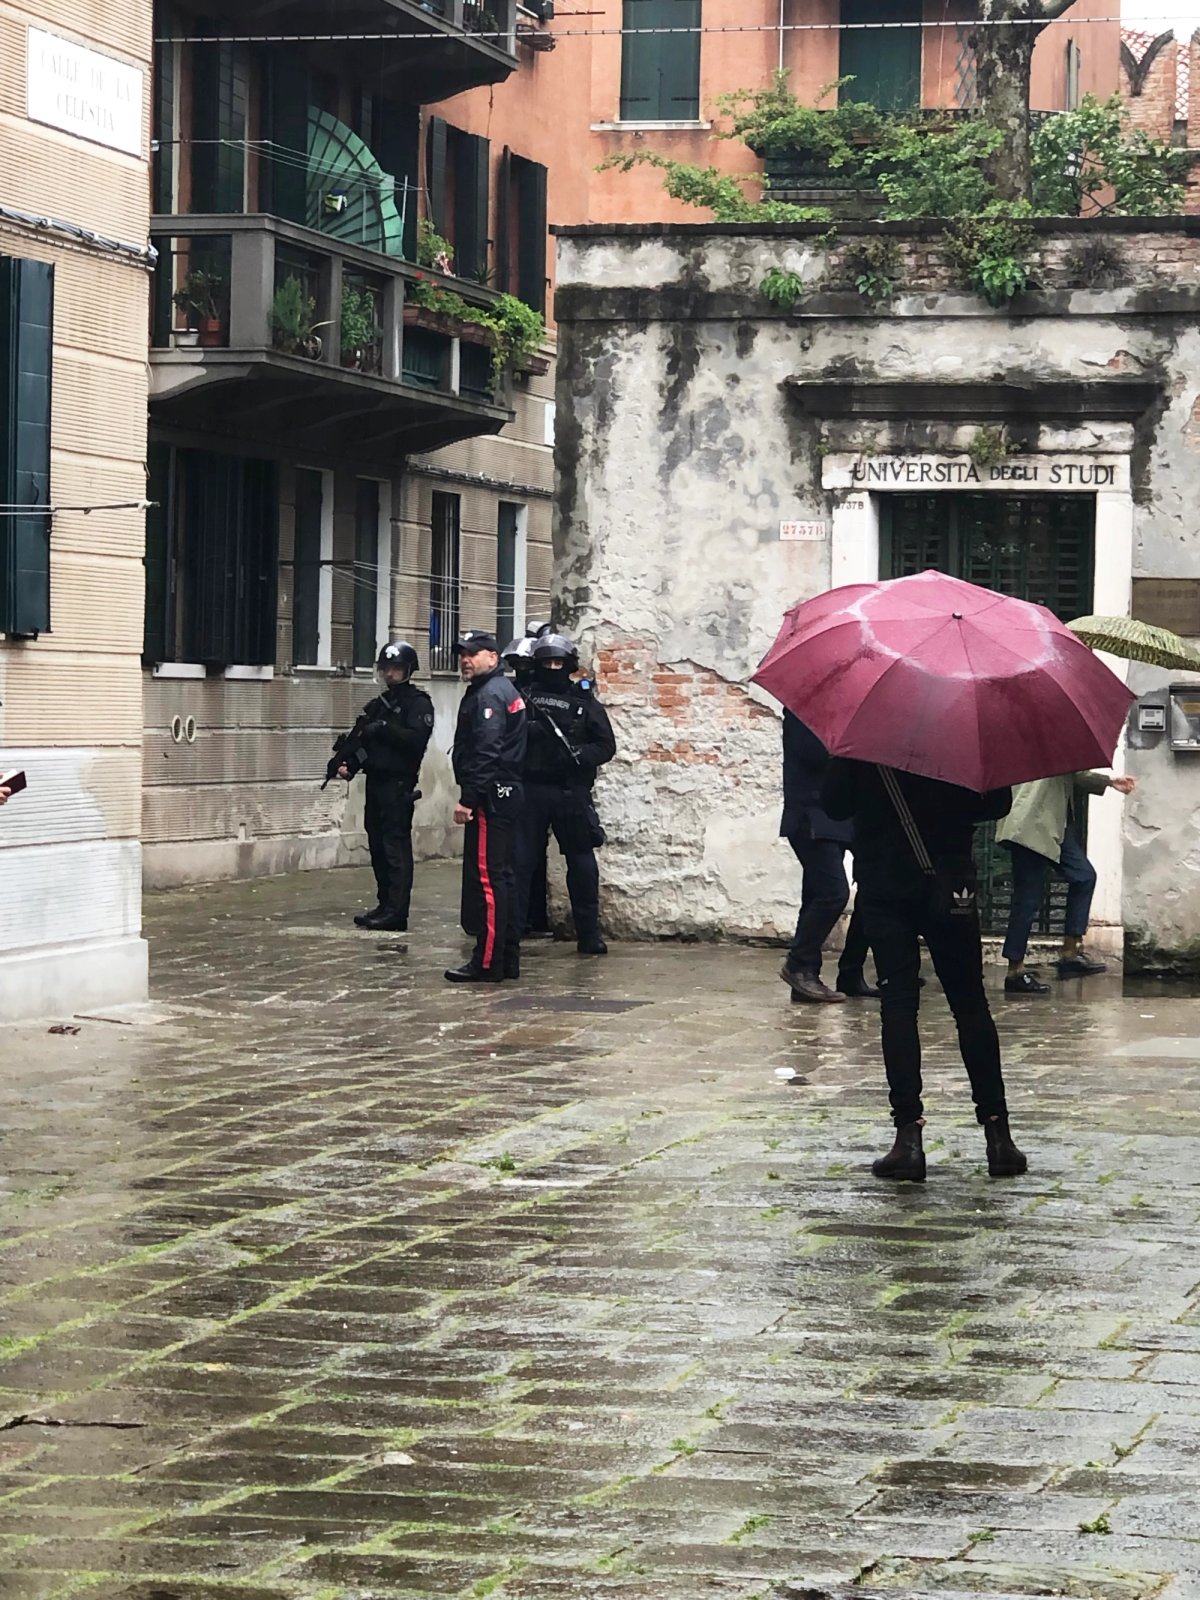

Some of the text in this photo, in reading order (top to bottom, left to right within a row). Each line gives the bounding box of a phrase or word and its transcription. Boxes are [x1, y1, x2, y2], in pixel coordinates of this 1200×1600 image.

[41, 48, 130, 102] CALLE DE LA
[56, 93, 114, 131] CELESTIA
[990, 465, 1038, 481] DEGLI
[1049, 464, 1115, 485] STUDI
[532, 696, 571, 710] CARABINIERI
